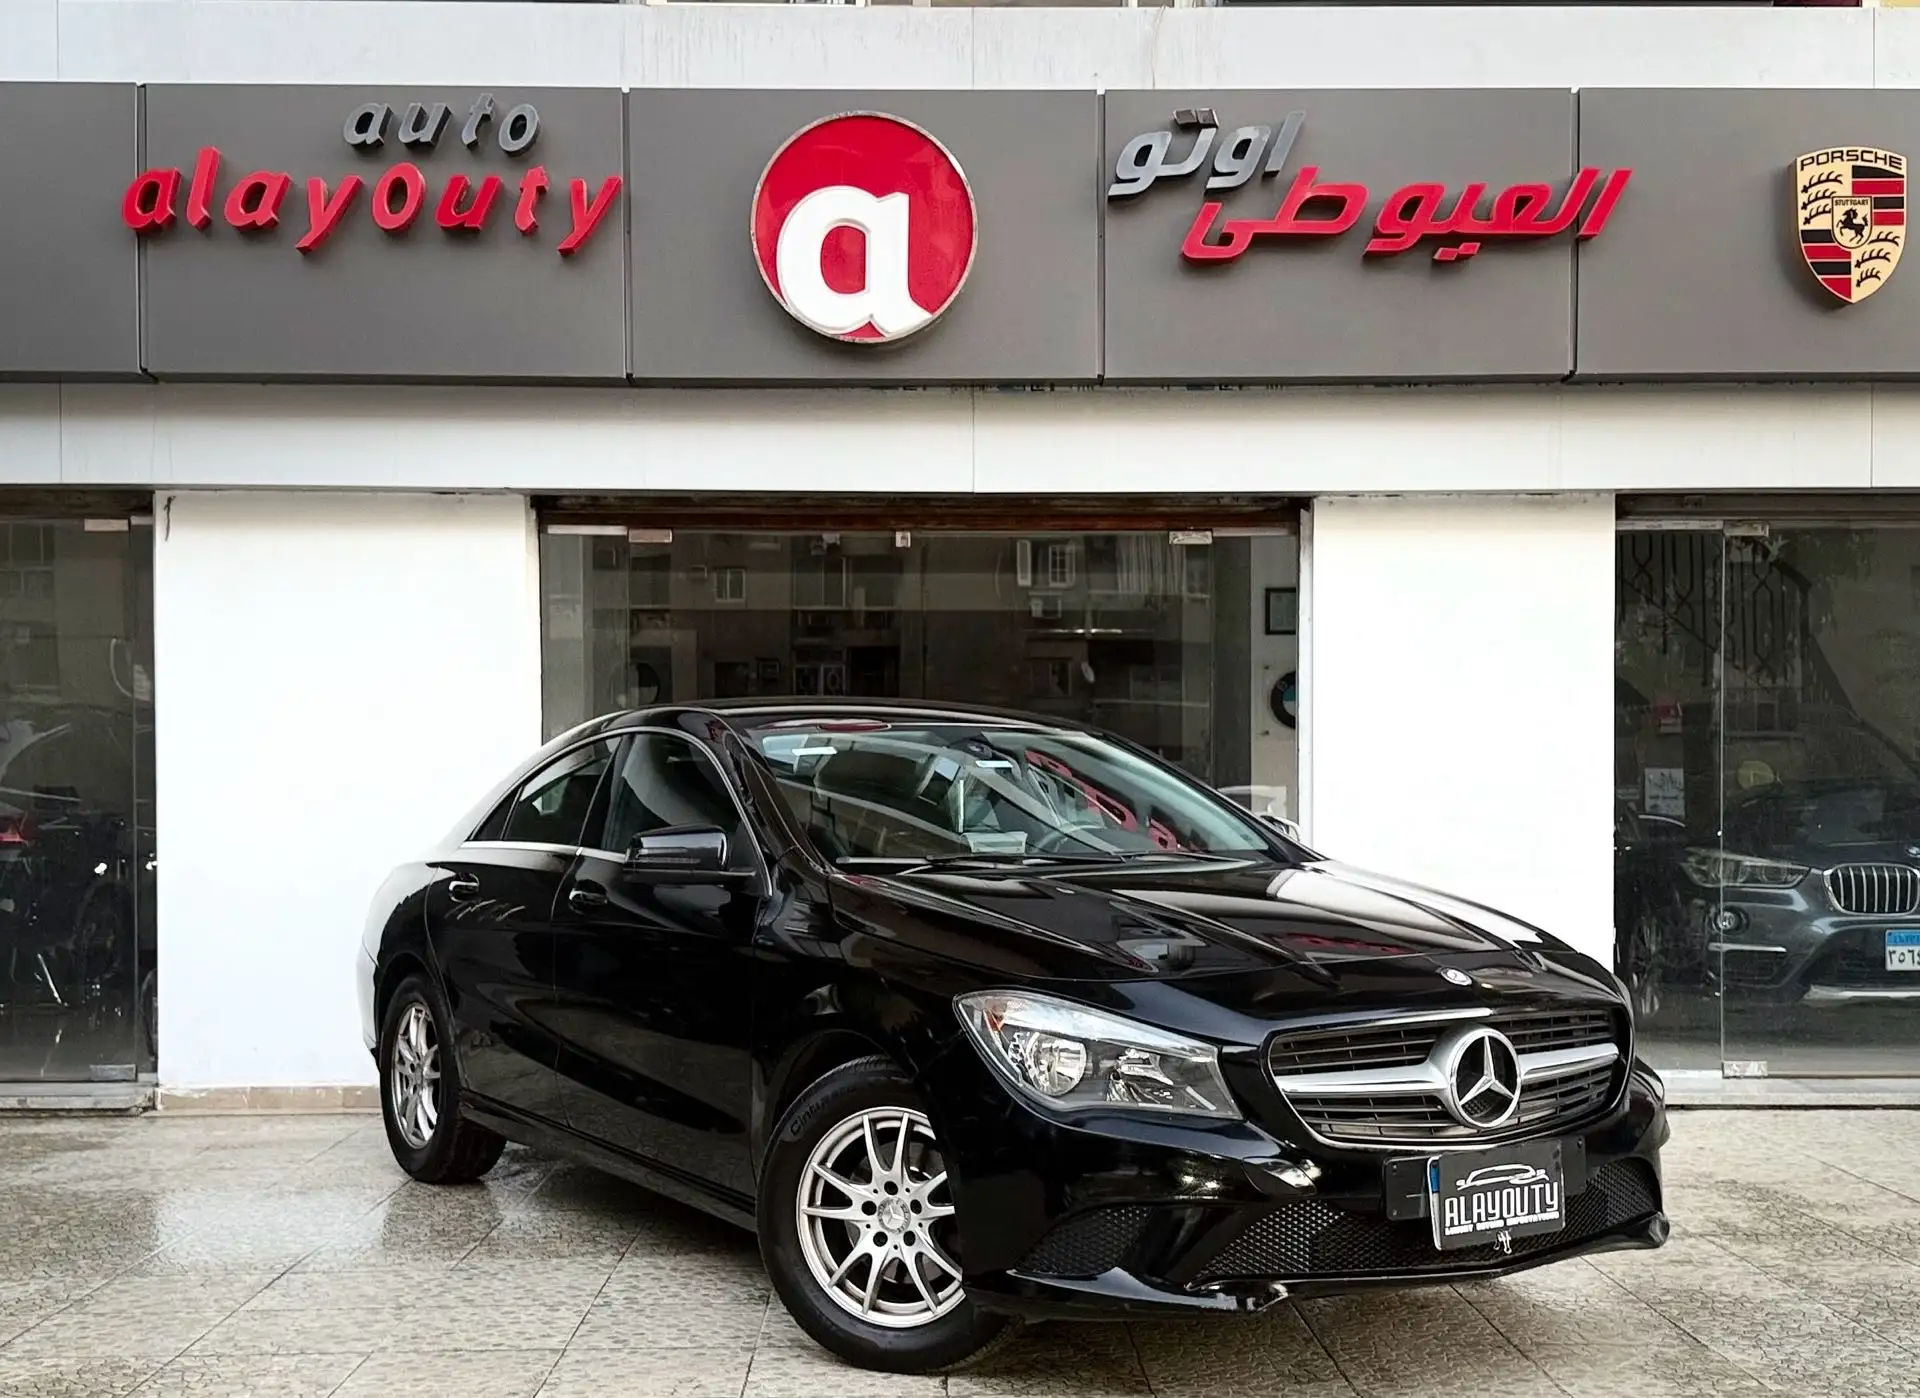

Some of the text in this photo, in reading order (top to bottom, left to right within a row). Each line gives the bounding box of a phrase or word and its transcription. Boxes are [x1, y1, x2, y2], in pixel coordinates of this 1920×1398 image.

[344, 92, 541, 153] auto
[1800, 149, 1903, 171] PORSCHE
[1834, 199, 1869, 207] STUTTGART
[776, 184, 934, 338] a
[1444, 1181, 1559, 1227] ALAYOUTY
